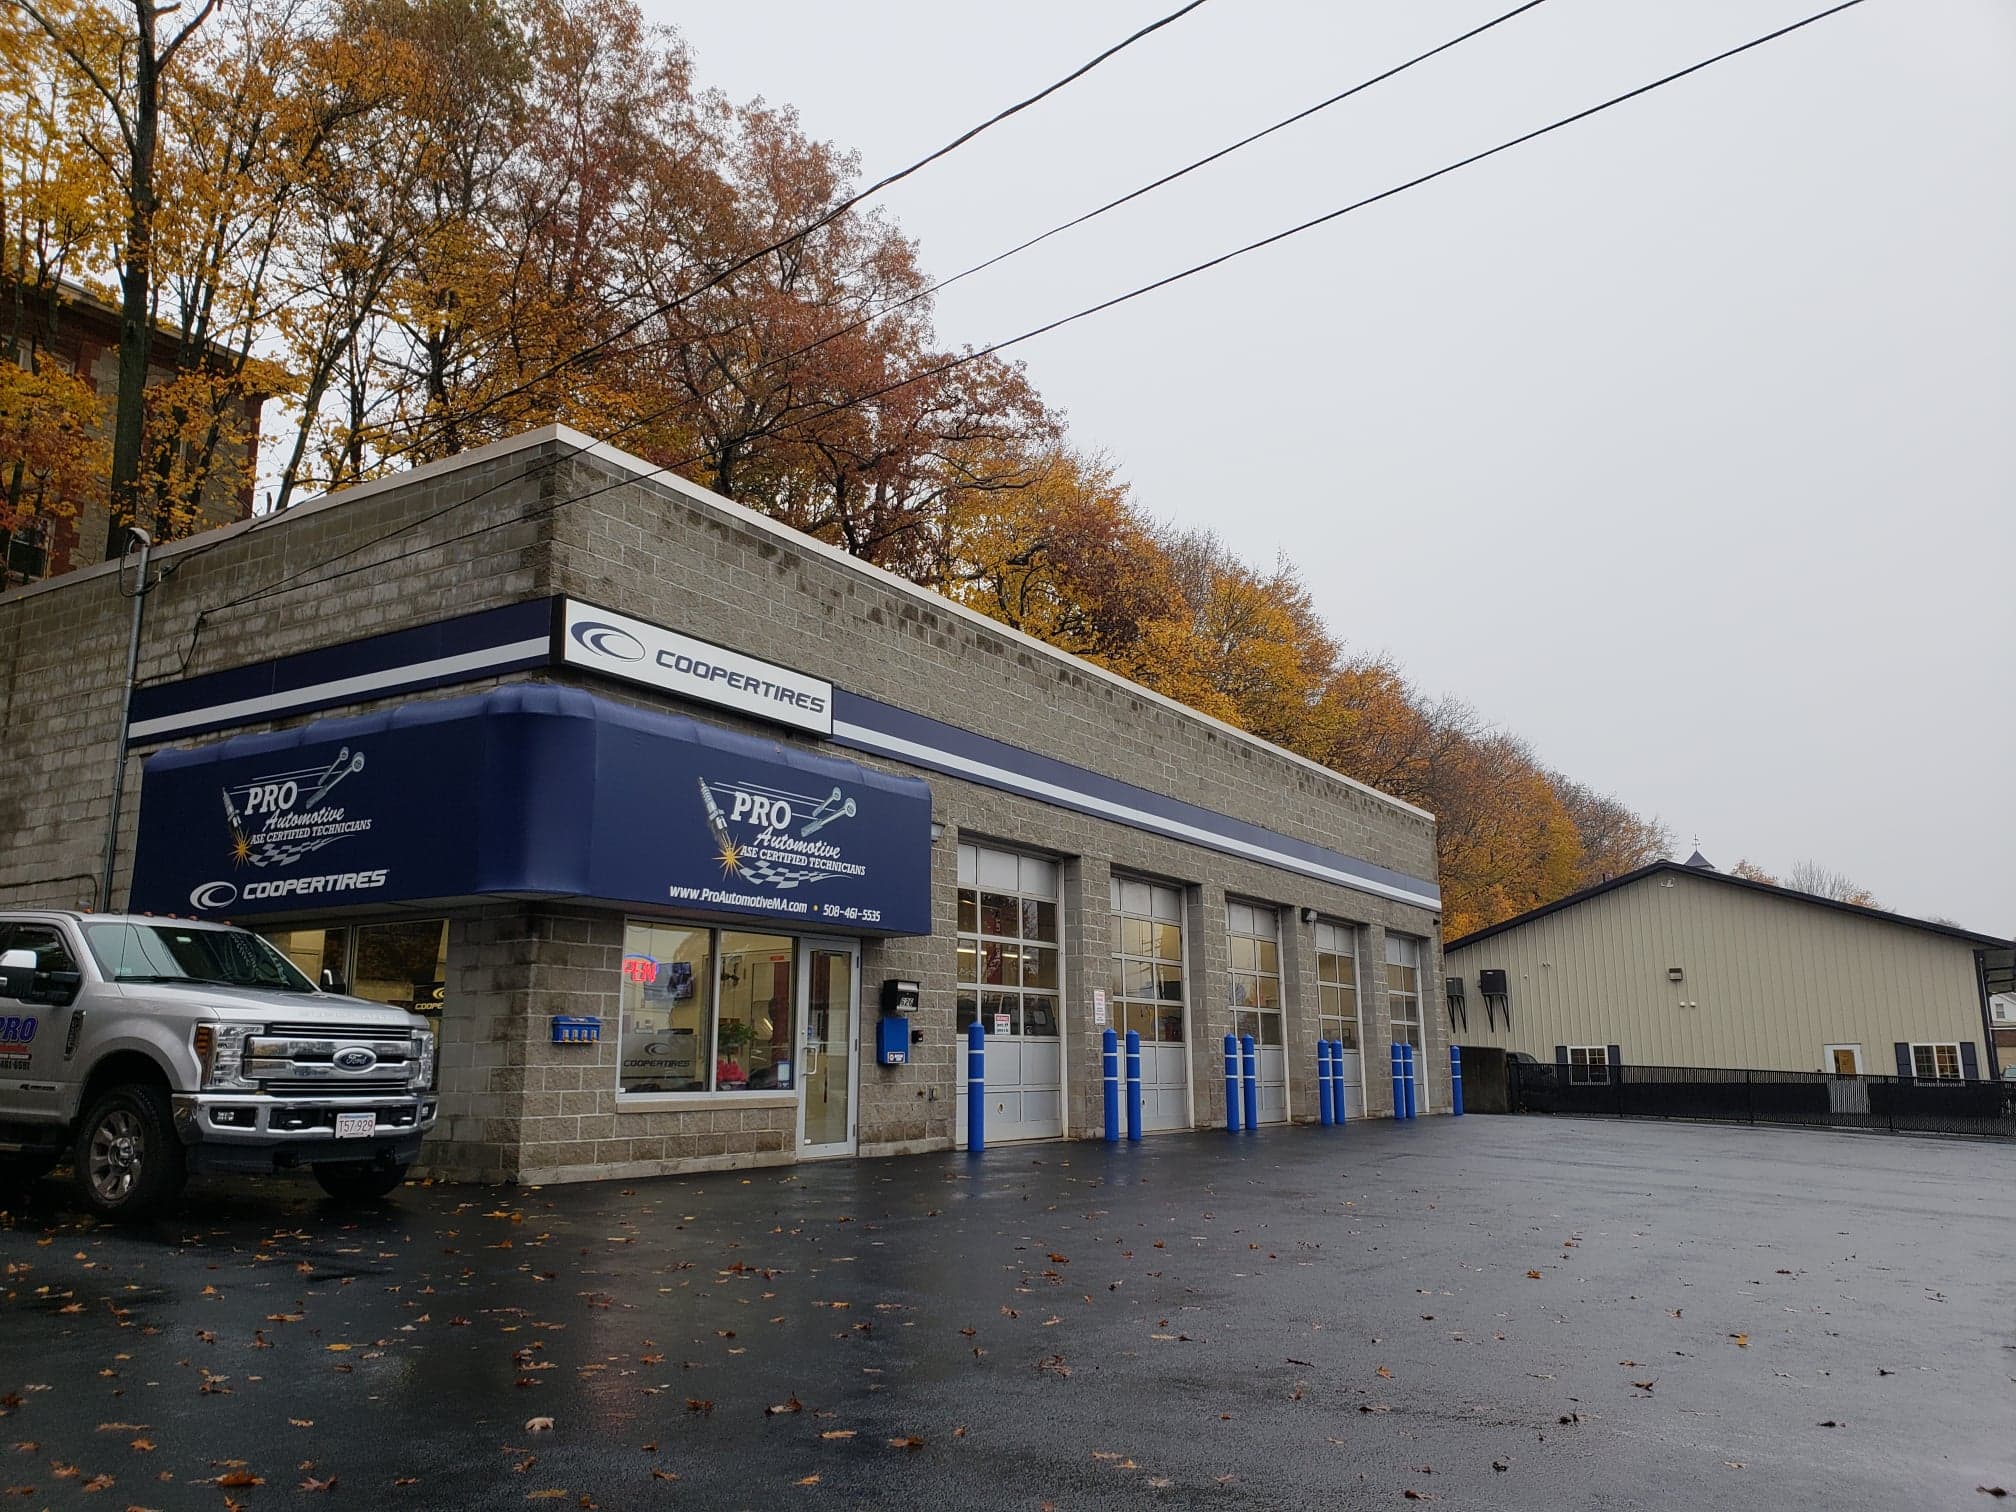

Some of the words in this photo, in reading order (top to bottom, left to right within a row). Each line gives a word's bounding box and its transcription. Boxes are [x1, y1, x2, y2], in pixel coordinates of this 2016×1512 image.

[655, 649, 825, 714] COOPERTIRES
[244, 781, 298, 816] PRO
[730, 791, 792, 830] PRO
[250, 830, 265, 845] ASE
[266, 825, 311, 842] CERTIFIED
[311, 819, 372, 836] TECHNICIANS
[262, 806, 345, 832] Automotive
[754, 826, 841, 859] Automotive
[740, 845, 758, 858] ASE
[760, 849, 807, 866] CERTIFIED
[809, 857, 866, 876] TECHNICIANS
[242, 869, 389, 900] COOPERTIRES
[669, 885, 808, 913] www.ProAutomotiveMA.com
[822, 904, 881, 922] 508-461-5535
[624, 959, 656, 983] PEN
[346, 1053, 367, 1065] Ford
